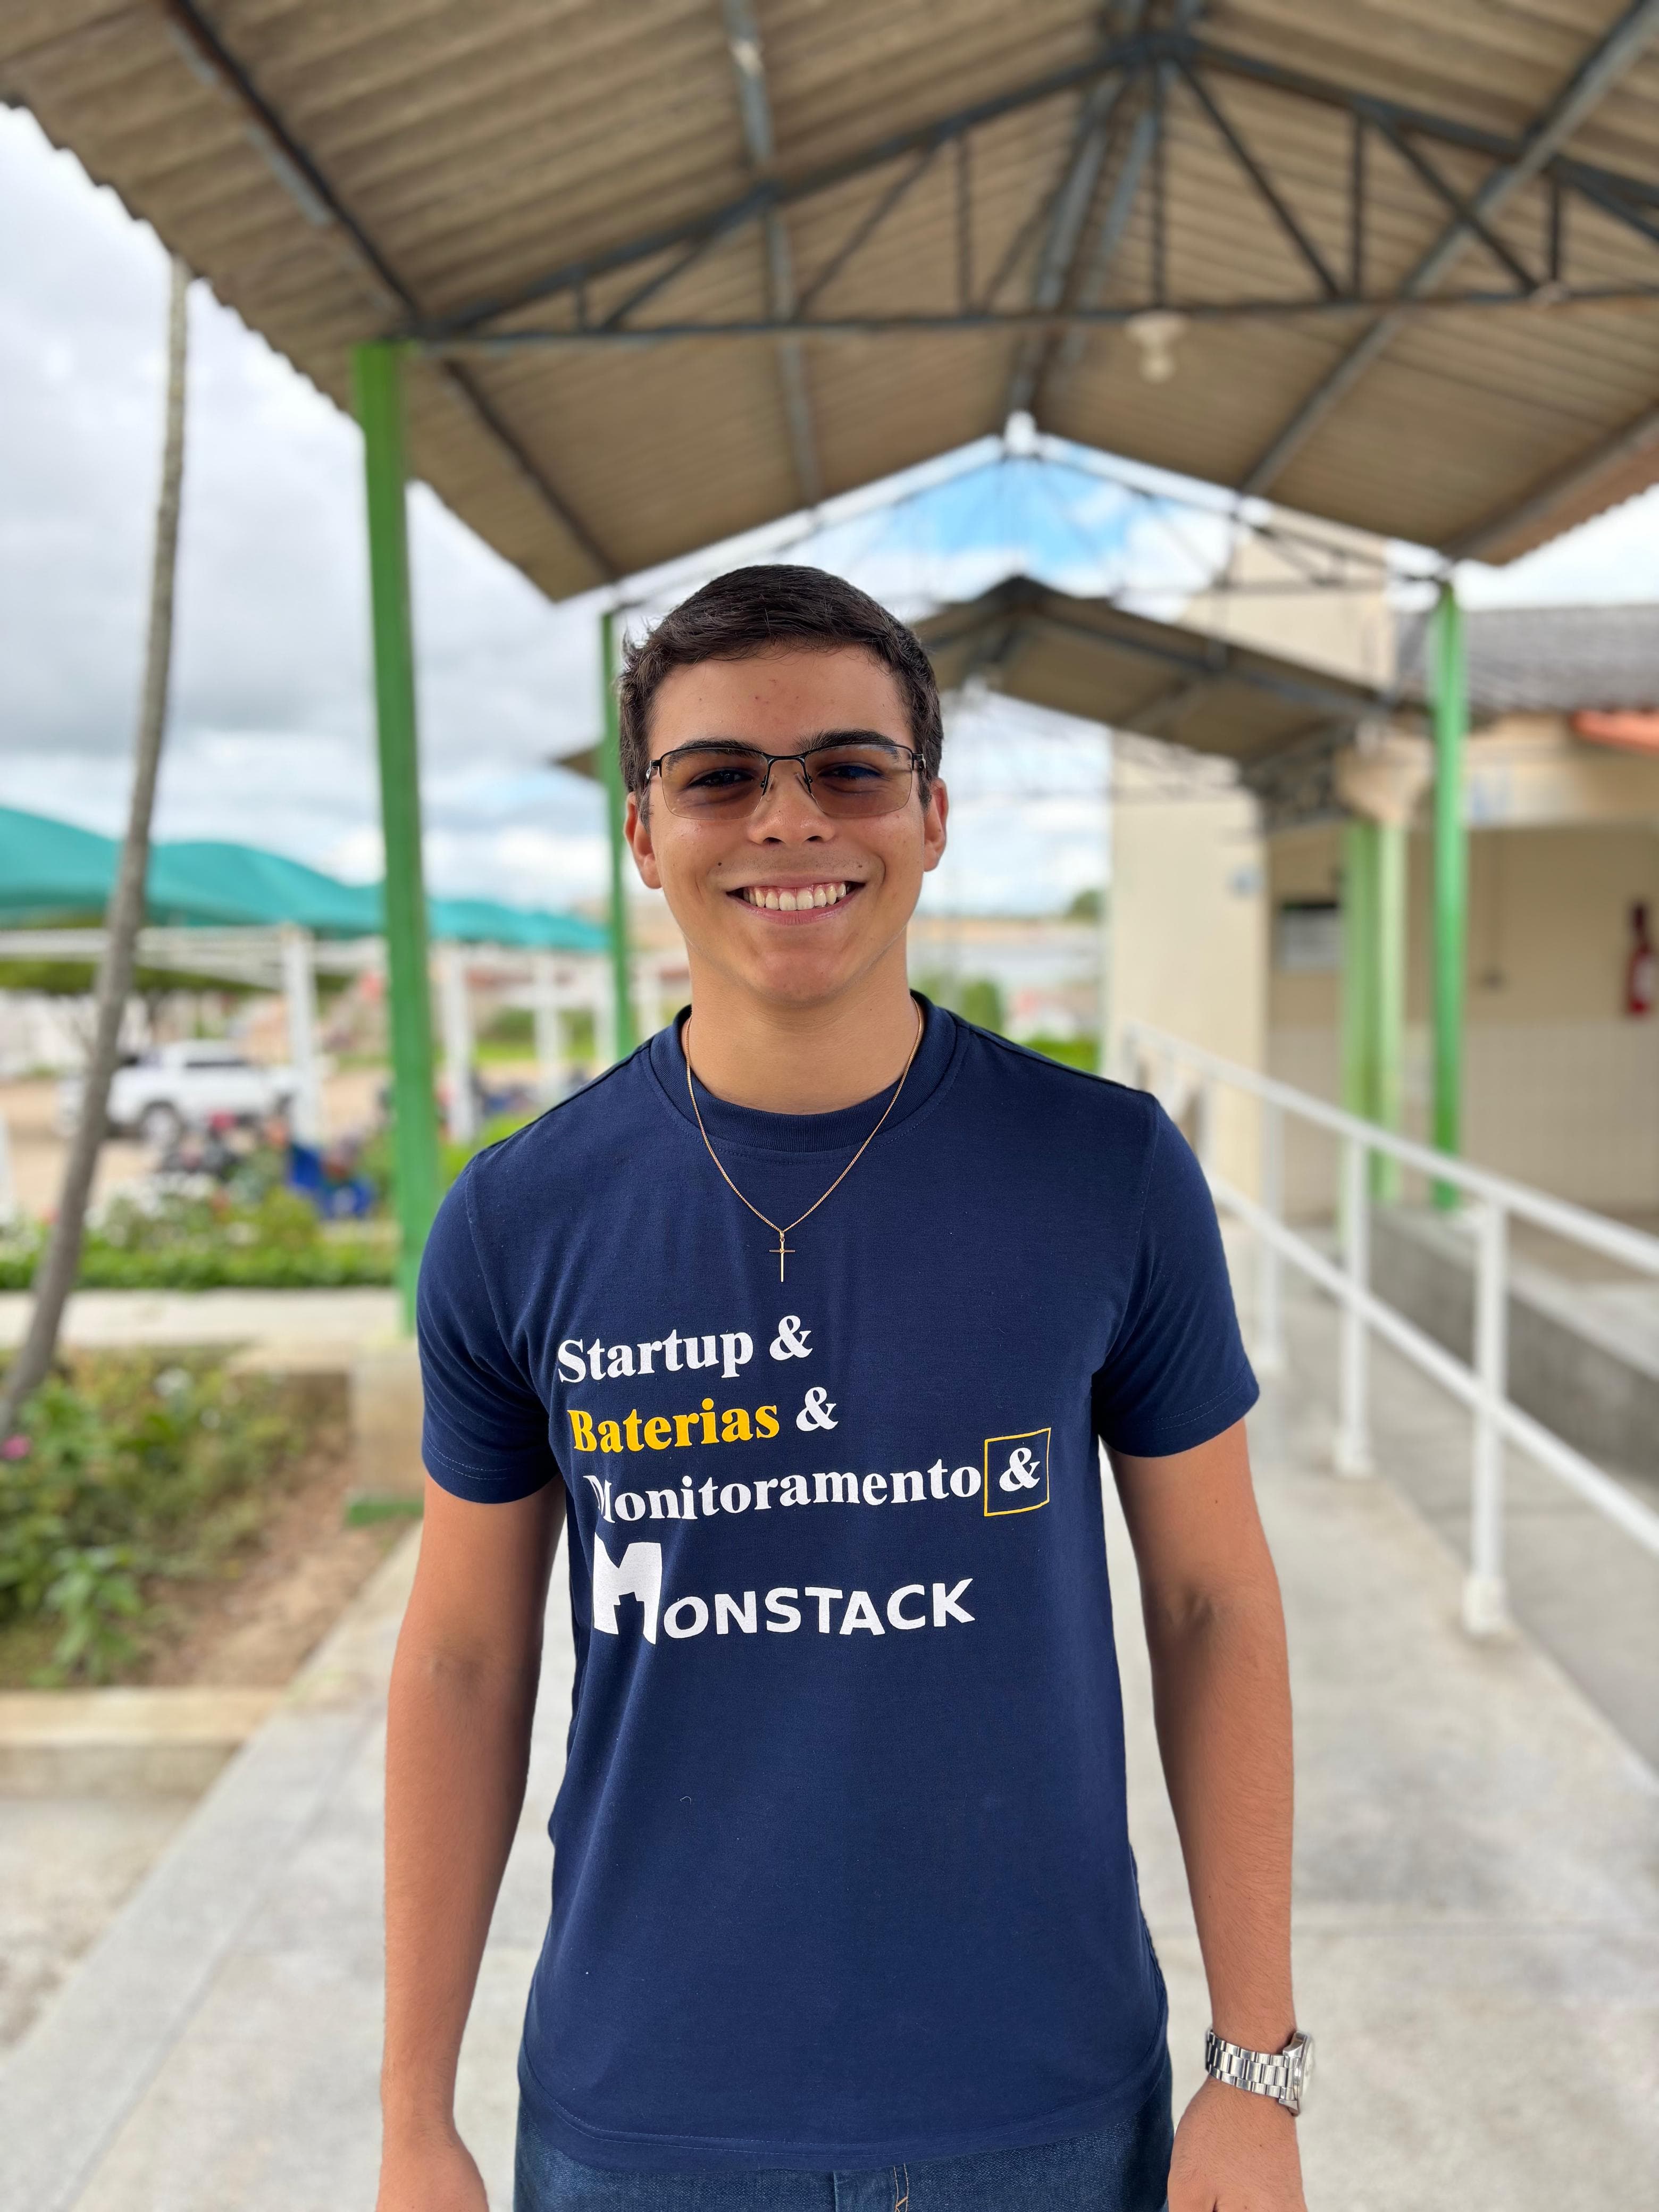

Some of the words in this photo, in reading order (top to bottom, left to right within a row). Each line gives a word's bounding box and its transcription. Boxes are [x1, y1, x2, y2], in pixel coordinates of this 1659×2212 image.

[557, 1328, 753, 1383] Startup
[769, 1315, 813, 1361] &
[567, 1398, 780, 1453] Baterias
[795, 1386, 839, 1431] &
[582, 1459, 982, 1523] Monitoramento
[999, 1447, 1041, 1492] &
[592, 1531, 976, 1645] MONSTACK
